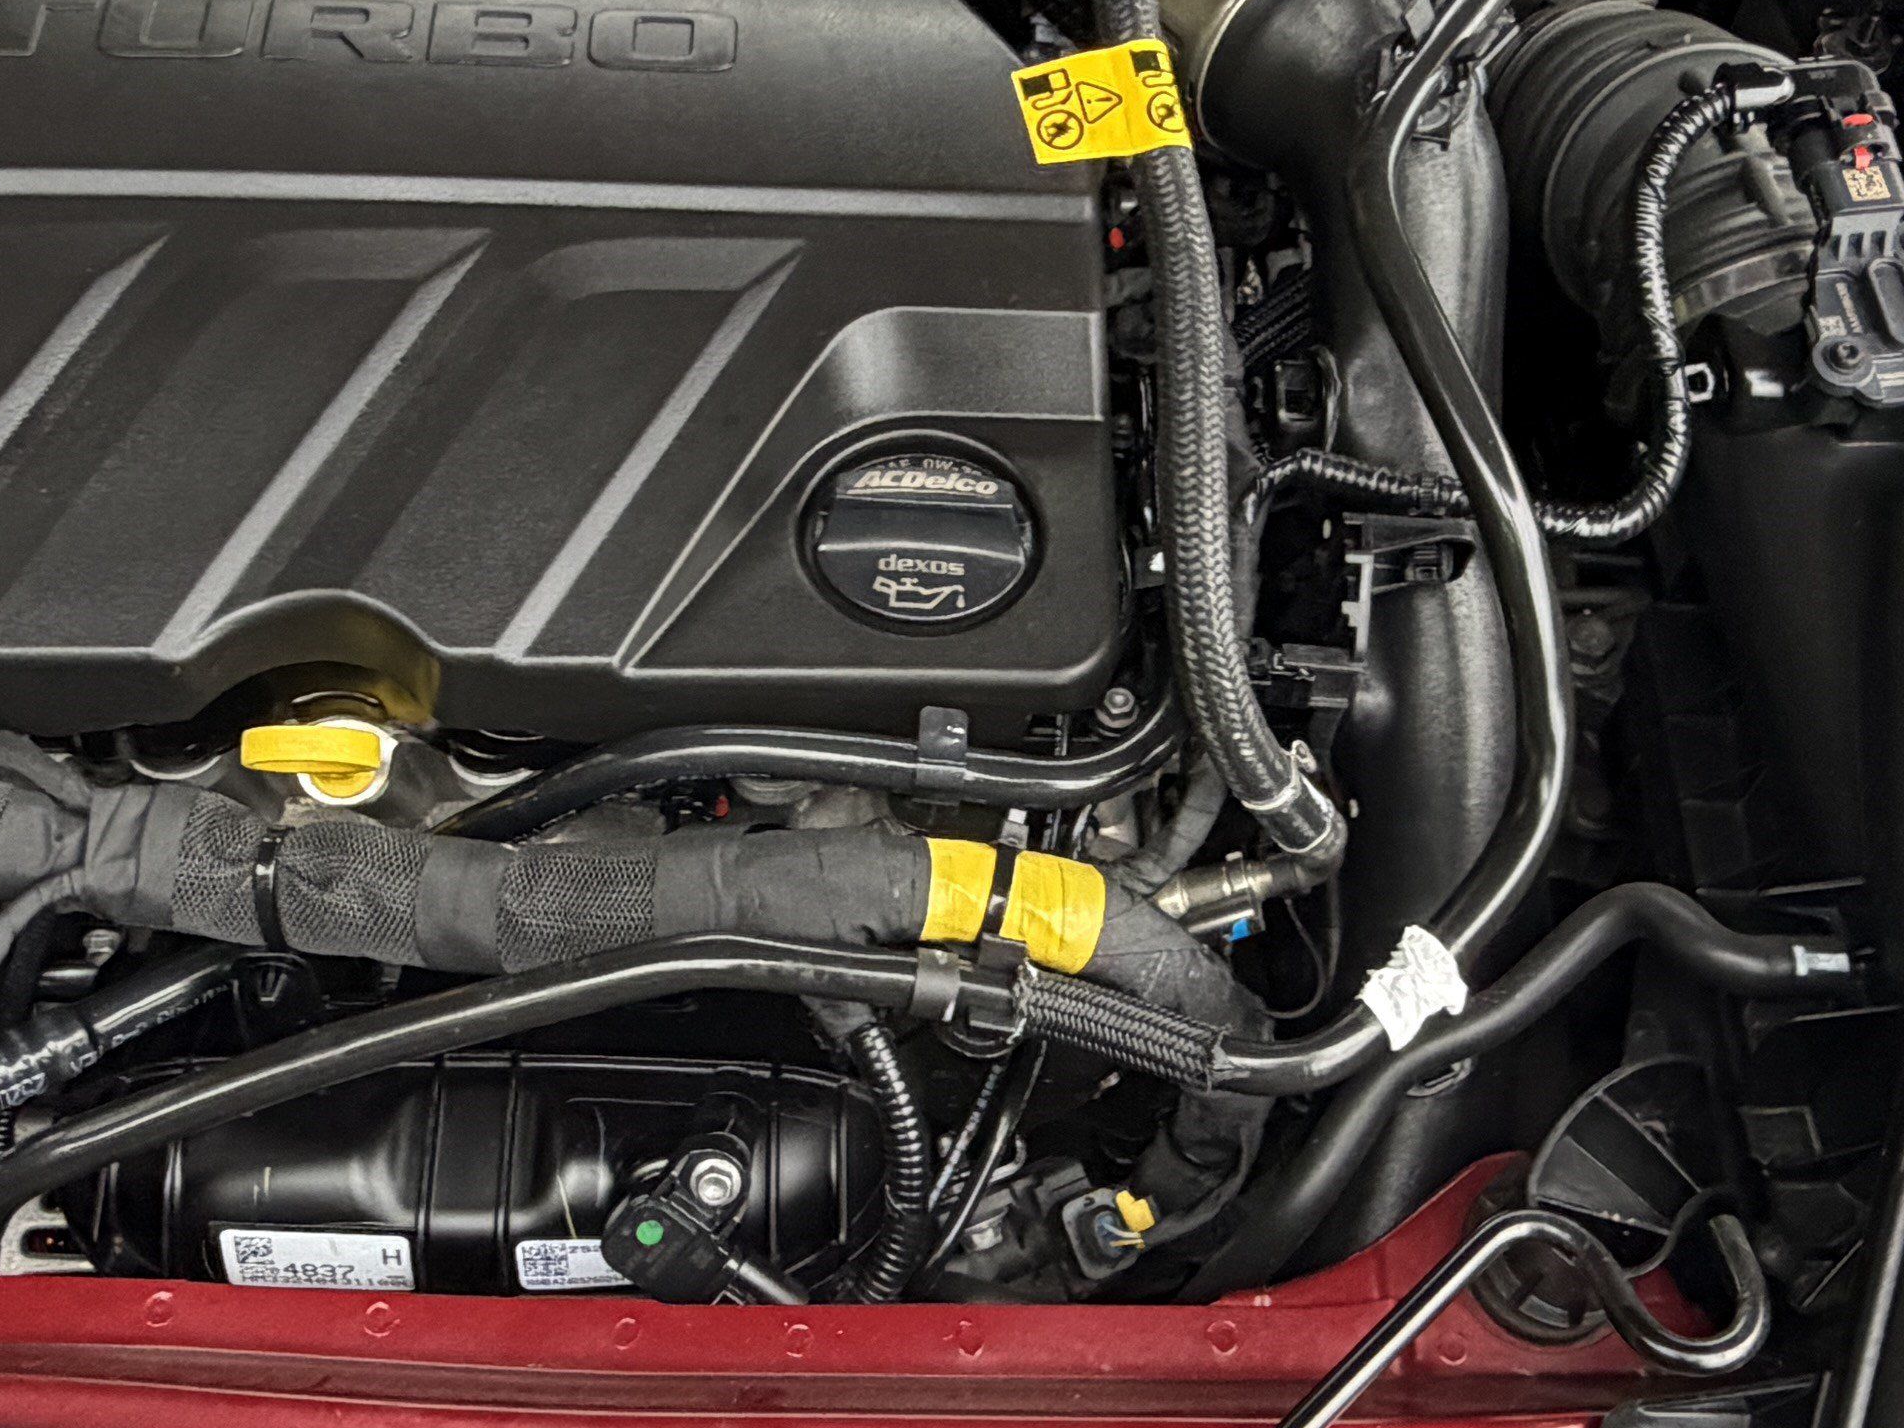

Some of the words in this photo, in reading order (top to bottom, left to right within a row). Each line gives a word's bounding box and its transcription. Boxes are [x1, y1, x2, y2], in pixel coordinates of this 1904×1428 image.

[854, 470, 998, 495] ACDelco
[878, 554, 965, 576] dexos
[382, 1248, 402, 1266] H
[283, 1263, 354, 1279] 4837
